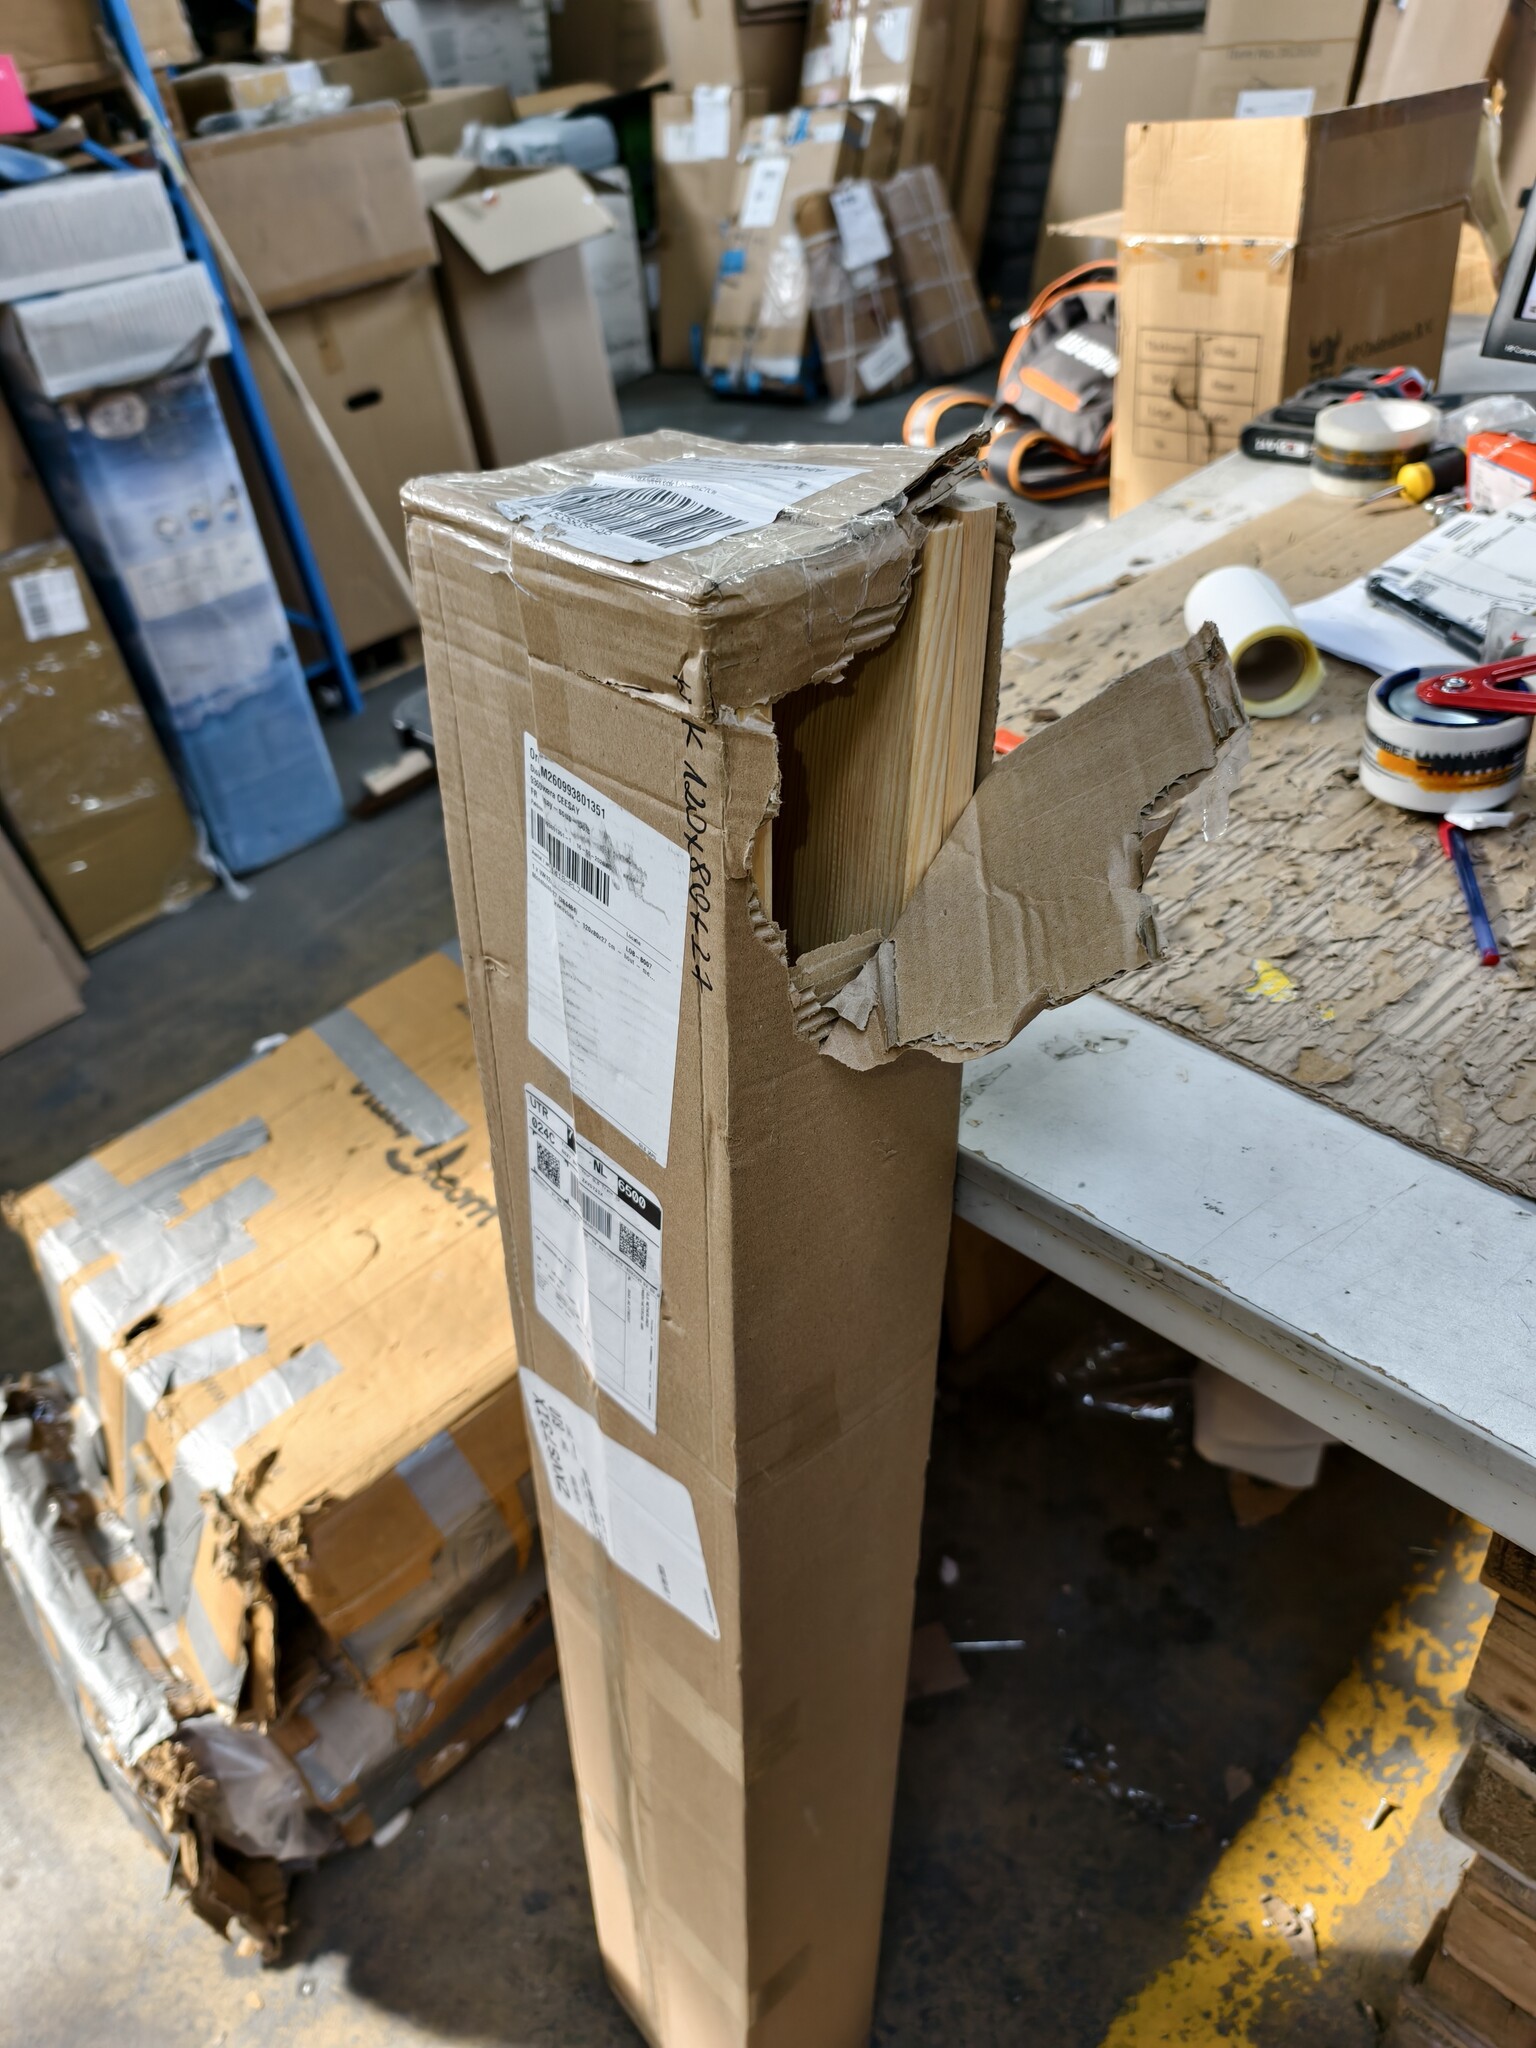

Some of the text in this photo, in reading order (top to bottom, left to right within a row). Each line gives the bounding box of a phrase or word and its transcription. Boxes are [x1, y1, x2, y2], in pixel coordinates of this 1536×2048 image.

[540, 765, 605, 820] M260993801351
[557, 793, 580, 816] CEESAY
[531, 1116, 556, 1145] 024C
[530, 1095, 549, 1120] UTR
[593, 1159, 608, 1180] NL
[618, 1178, 647, 1210] 6500
